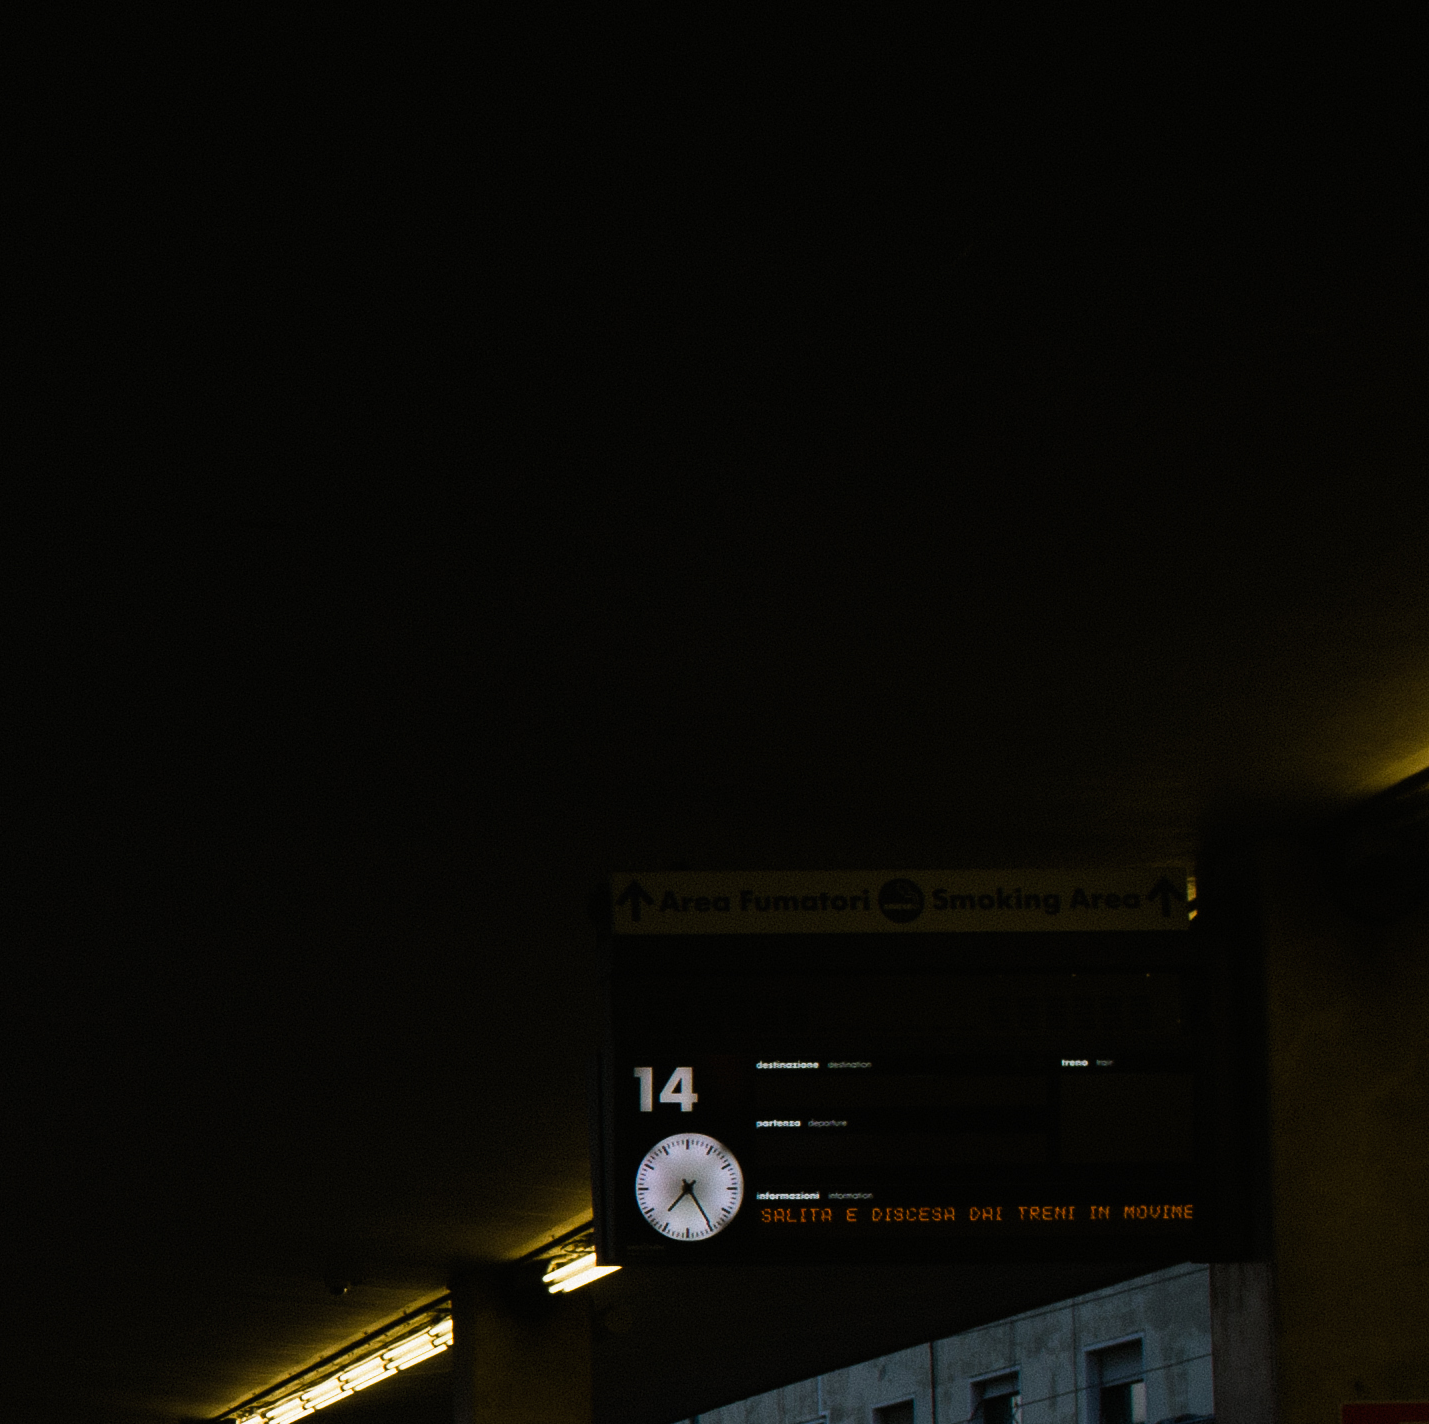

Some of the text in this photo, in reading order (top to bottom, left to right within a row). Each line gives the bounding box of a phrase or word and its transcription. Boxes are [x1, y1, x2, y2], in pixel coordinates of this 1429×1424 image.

[658, 888, 871, 913] Area Fumatori
[932, 886, 1141, 916] Smoking Area
[755, 1059, 873, 1070] destinazione destination
[1060, 1058, 1090, 1068] treno
[633, 1065, 700, 1113] 14
[755, 1117, 803, 1129] partenza
[755, 1189, 821, 1201] informazioni
[759, 1207, 834, 1224] SALITA
[845, 1206, 860, 1223] E
[871, 1206, 957, 1223] DISCESA
[968, 1205, 1004, 1223] DAI
[1017, 1204, 1077, 1222] TRENI
[1089, 1204, 1112, 1221] IN
